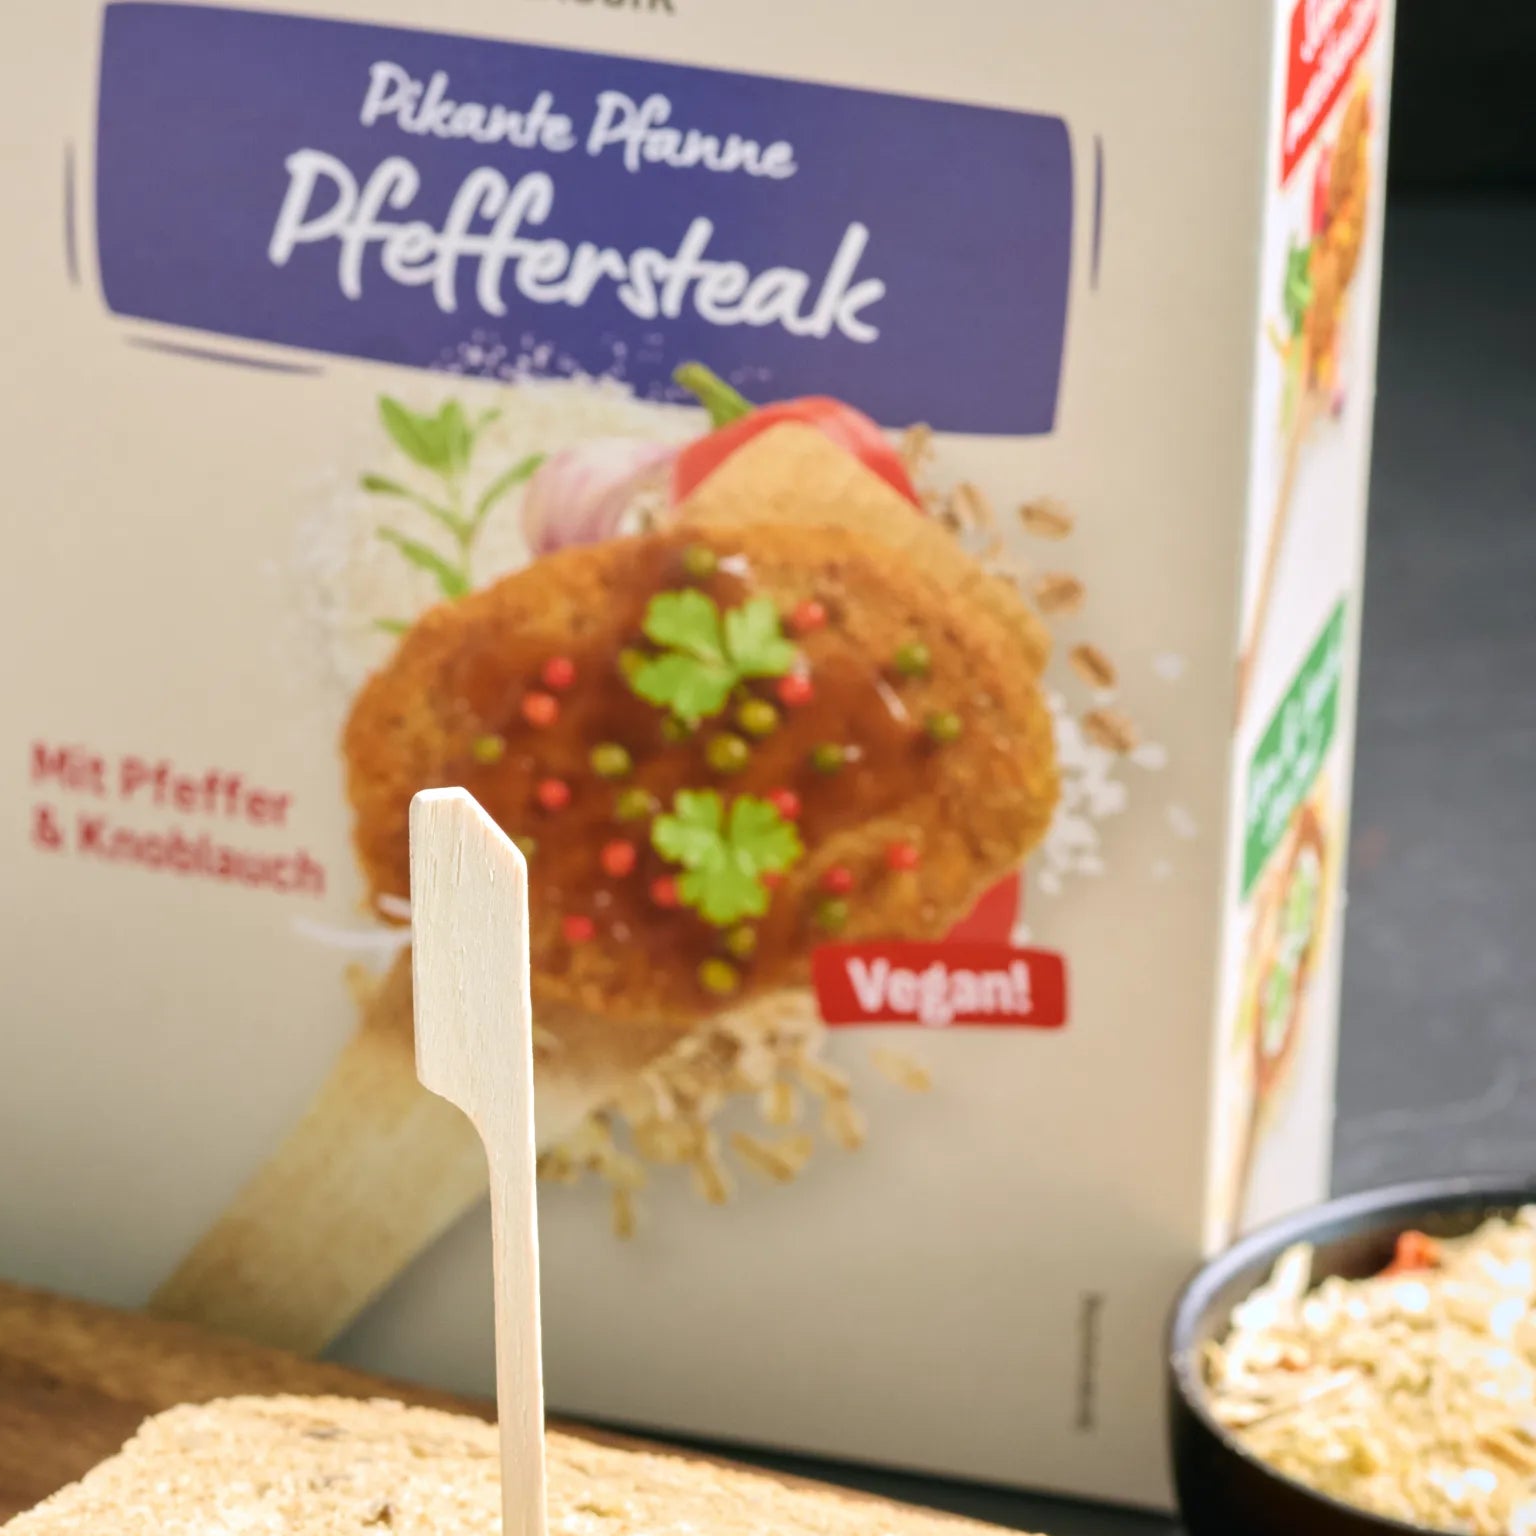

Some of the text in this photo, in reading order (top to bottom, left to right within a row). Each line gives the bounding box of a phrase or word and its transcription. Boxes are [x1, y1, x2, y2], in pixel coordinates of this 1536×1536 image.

[360, 60, 798, 180] Pikante Pfanne
[268, 148, 887, 344] Pfeffersteak
[31, 740, 292, 828] Mit Pfeffer
[31, 804, 325, 895] & Knoblauch
[845, 956, 1033, 1027] Vegan!
